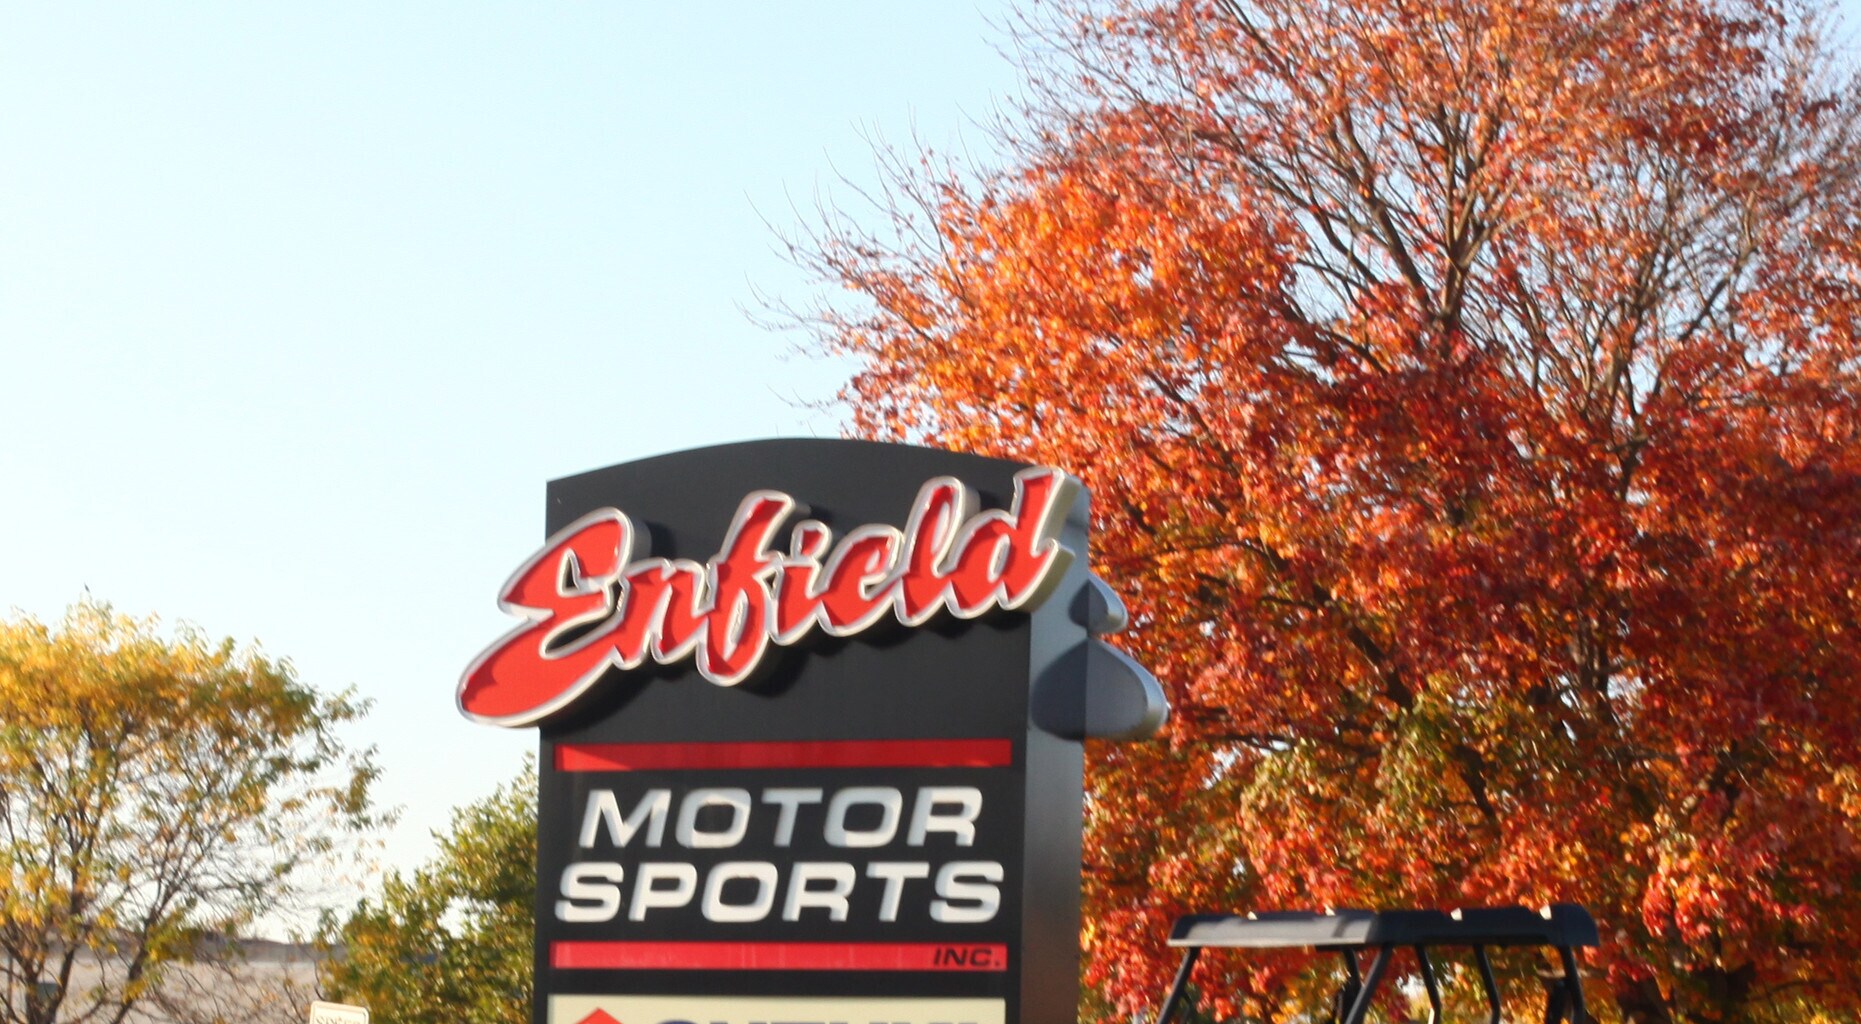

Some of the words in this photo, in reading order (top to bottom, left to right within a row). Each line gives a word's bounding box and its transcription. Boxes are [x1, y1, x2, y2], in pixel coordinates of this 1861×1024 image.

[456, 466, 1072, 728] Enfield
[578, 786, 983, 849] MOTOR
[555, 861, 1004, 924] SPORTS
[932, 947, 1001, 968] INC.
